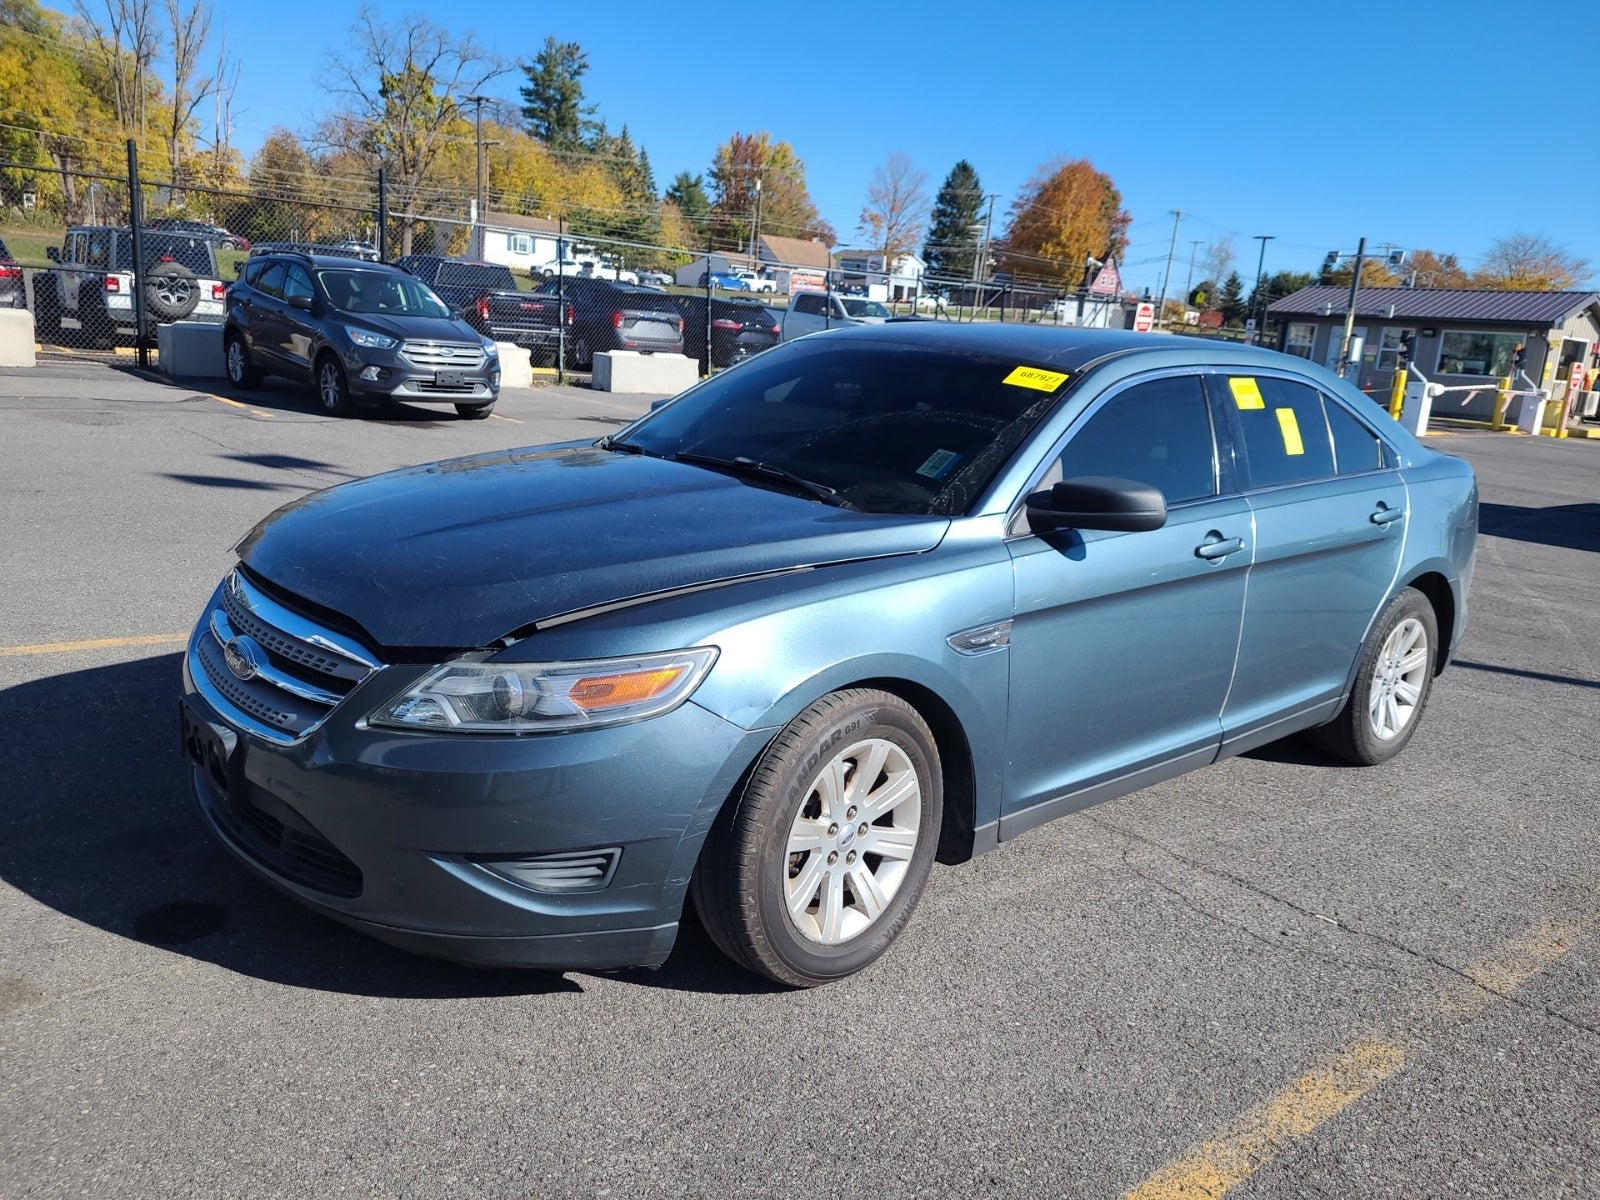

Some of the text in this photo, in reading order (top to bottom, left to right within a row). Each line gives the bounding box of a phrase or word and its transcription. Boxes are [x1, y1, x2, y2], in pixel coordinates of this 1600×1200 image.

[1020, 371, 1060, 383] 687927
[770, 719, 860, 853] OLANDAR G91
